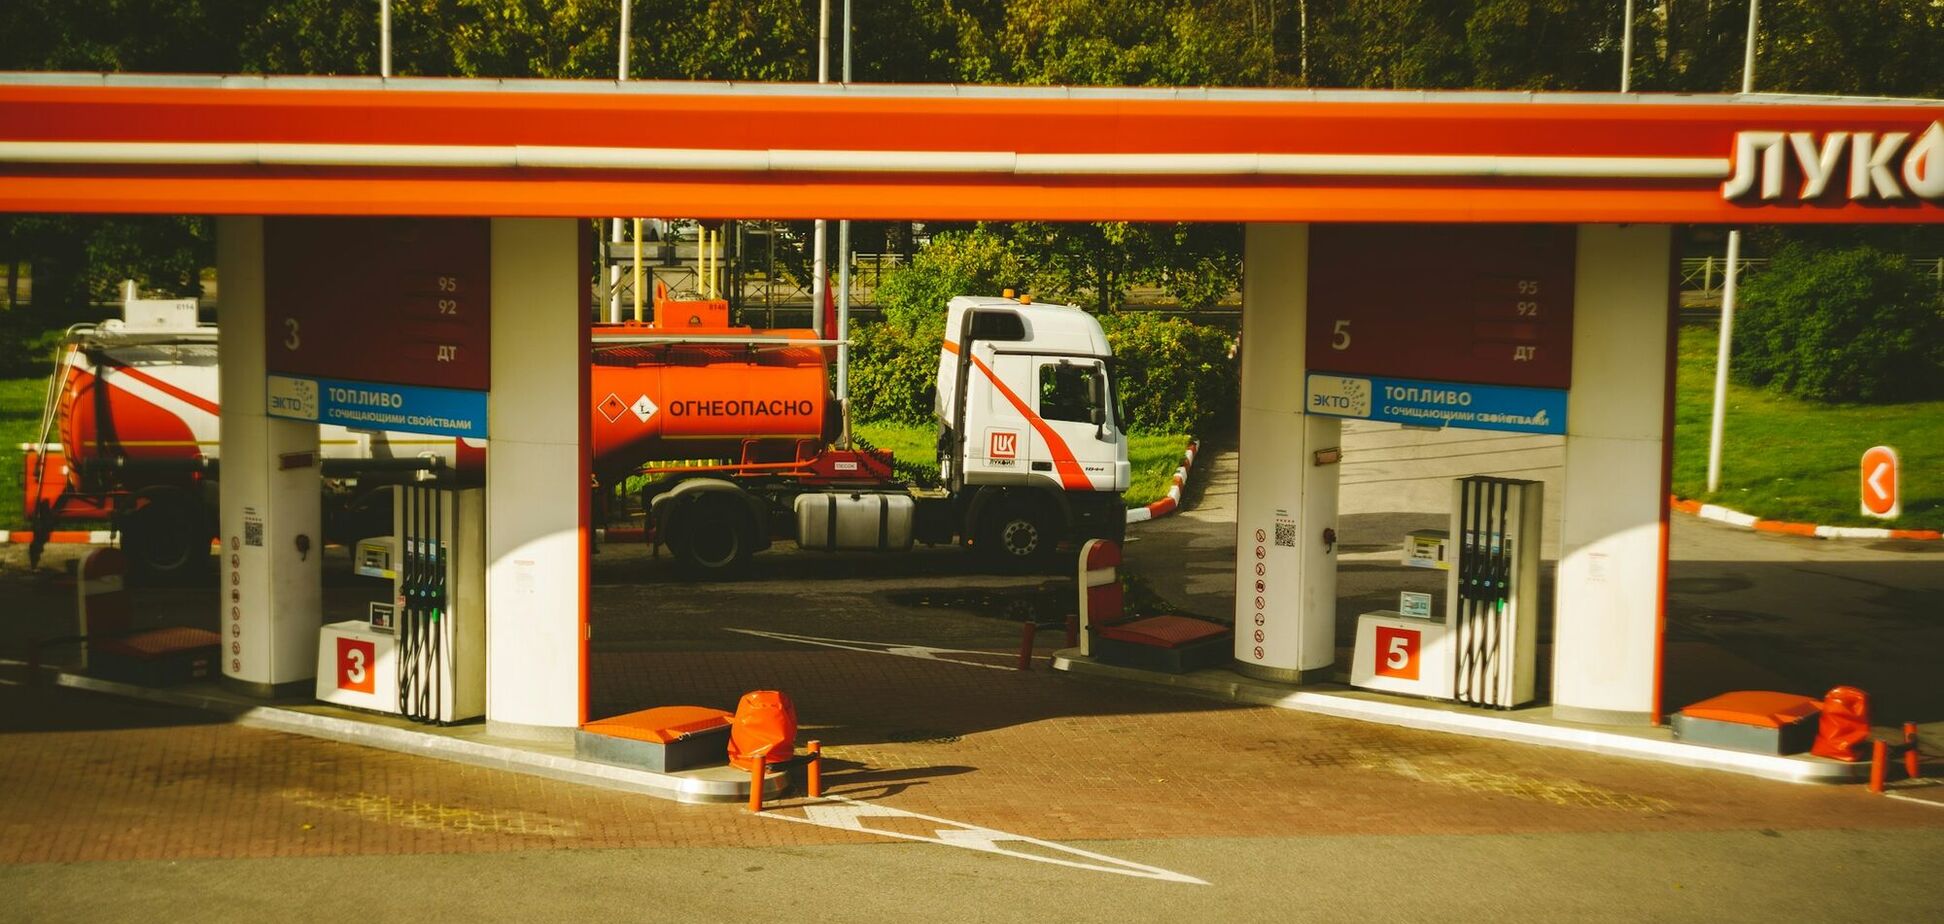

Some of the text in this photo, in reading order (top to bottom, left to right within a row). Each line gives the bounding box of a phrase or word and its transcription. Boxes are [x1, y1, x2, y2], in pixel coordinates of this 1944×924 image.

[439, 277, 456, 292] 95
[1518, 281, 1538, 295] 95
[439, 300, 456, 315] 92
[1517, 302, 1537, 316] 92
[285, 318, 300, 350] 3
[1331, 320, 1351, 350] 5
[437, 346, 456, 362] ДТ
[1513, 346, 1536, 361] ДТ
[272, 396, 302, 411] ЭКТО
[329, 387, 402, 409] ТОПЛИВО
[1313, 394, 1350, 409] ЭКТО
[1384, 386, 1472, 406] ТОПЛИВО
[670, 400, 813, 417] ОГНЕОПАСНО
[1384, 406, 1390, 415] С
[1392, 407, 1474, 422] ОЧИЩАЮЩИМИ
[328, 409, 472, 430] С ОЧИЩАЮЩИМИ СВОЙСТВАМИ
[993, 434, 1015, 456] LUK
[1386, 637, 1409, 670] 5
[347, 648, 366, 684] 3
